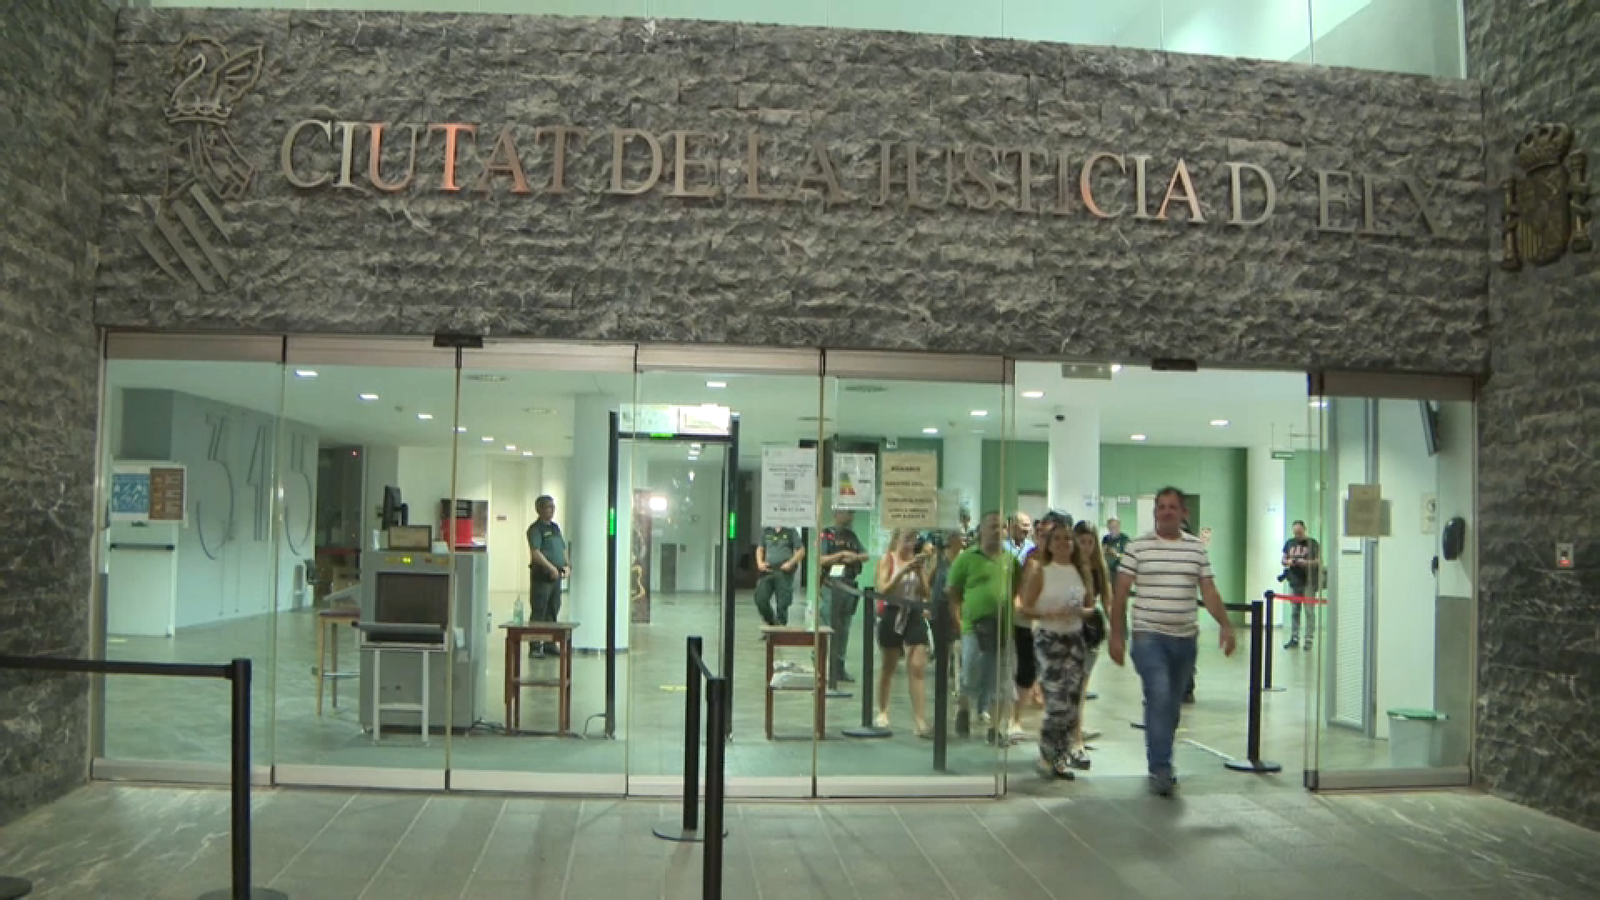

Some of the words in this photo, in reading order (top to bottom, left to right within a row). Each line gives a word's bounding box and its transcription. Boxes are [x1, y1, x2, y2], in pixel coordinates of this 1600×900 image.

[281, 119, 586, 195] CIUTAT
[605, 127, 718, 198] DE
[731, 133, 851, 204] LA
[868, 141, 1206, 222] JUSTICIA
